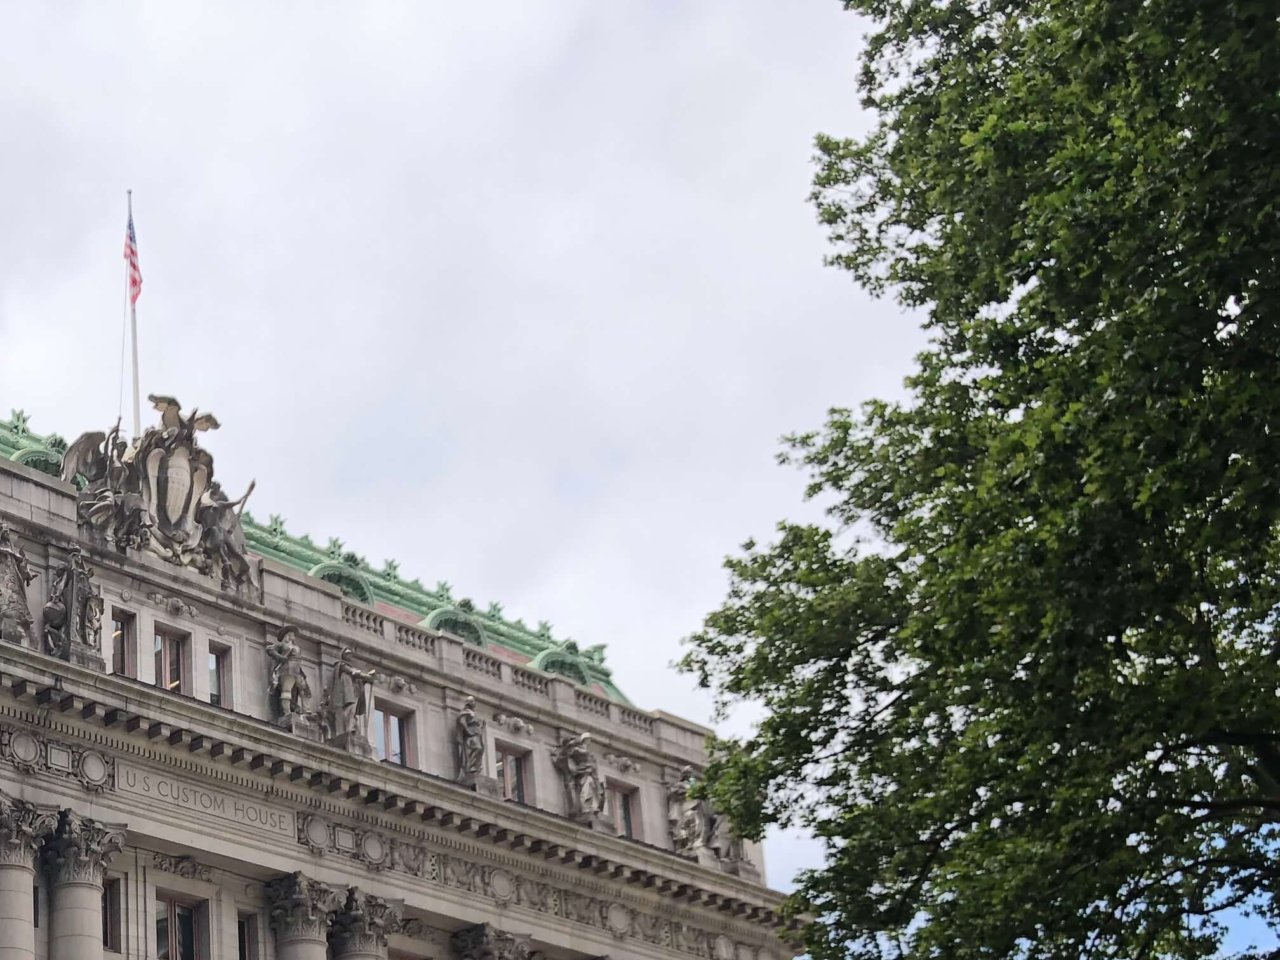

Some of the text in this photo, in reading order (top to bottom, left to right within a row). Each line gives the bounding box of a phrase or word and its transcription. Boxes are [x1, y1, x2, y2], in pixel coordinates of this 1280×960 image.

[126, 771, 288, 831] U S CUSTOM HOUSE
